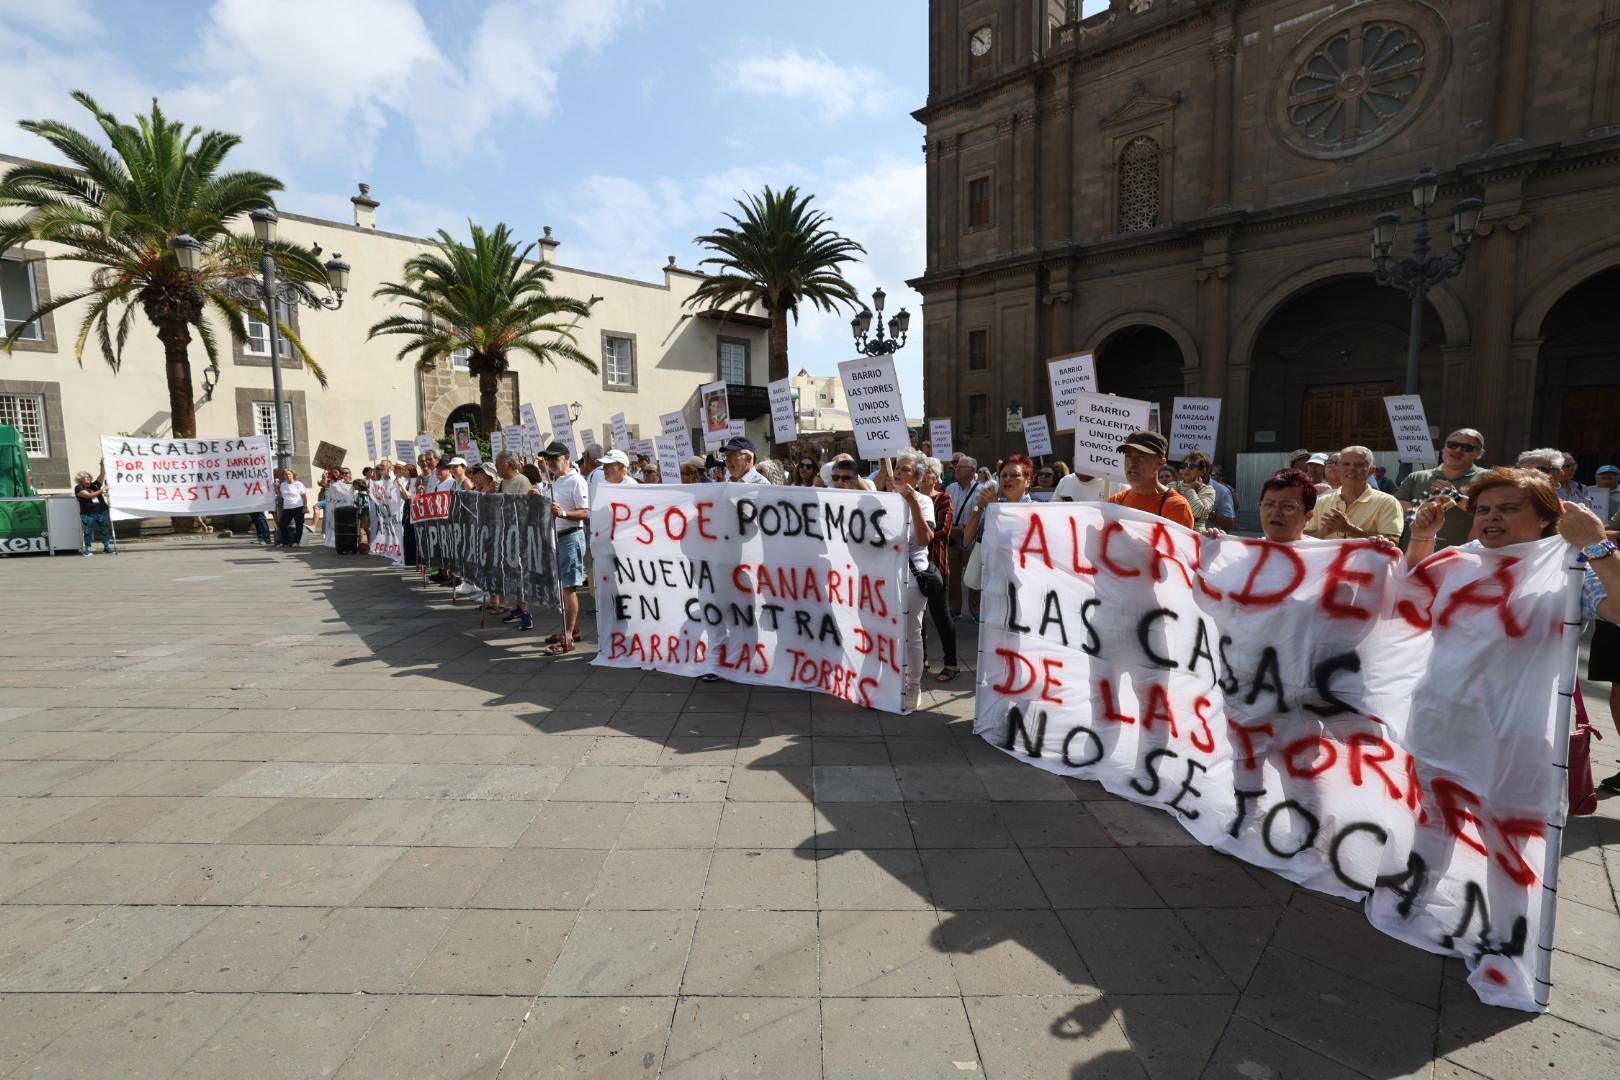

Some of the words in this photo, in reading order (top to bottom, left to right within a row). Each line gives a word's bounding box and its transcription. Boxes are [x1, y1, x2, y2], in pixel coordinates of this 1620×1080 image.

[851, 368, 882, 381] BARRIO
[847, 387, 862, 397] LAS
[863, 383, 894, 396] TORRES
[858, 400, 890, 411] UNIDOS
[1055, 399, 1077, 408] SOMO
[1090, 404, 1131, 418] BARRIO
[855, 416, 882, 426] SOMOS
[1079, 415, 1141, 432] ESCALERITAS
[866, 430, 891, 441] LPGC
[1080, 440, 1114, 453] SOMOS
[115, 459, 145, 471] POR
[152, 458, 221, 471] NUESTROS
[1089, 454, 1120, 468] LPGC
[116, 472, 145, 483] POR
[152, 472, 220, 484] NUESTRAS
[145, 485, 230, 502] ¡BASTA
[244, 480, 272, 497] YA!
[613, 556, 716, 594] NUEVA
[612, 594, 662, 621] EN
[684, 597, 843, 647] CONTRA
[852, 627, 901, 674] DEL
[1006, 582, 1103, 658] LAS
[1137, 608, 1363, 717] CASAS
[718, 643, 770, 676] LAS
[786, 648, 879, 708] TORRES
[993, 647, 1065, 706] DE
[1098, 677, 1216, 754] LAS
[1003, 705, 1104, 769] NO
[1130, 748, 1208, 821] SE
